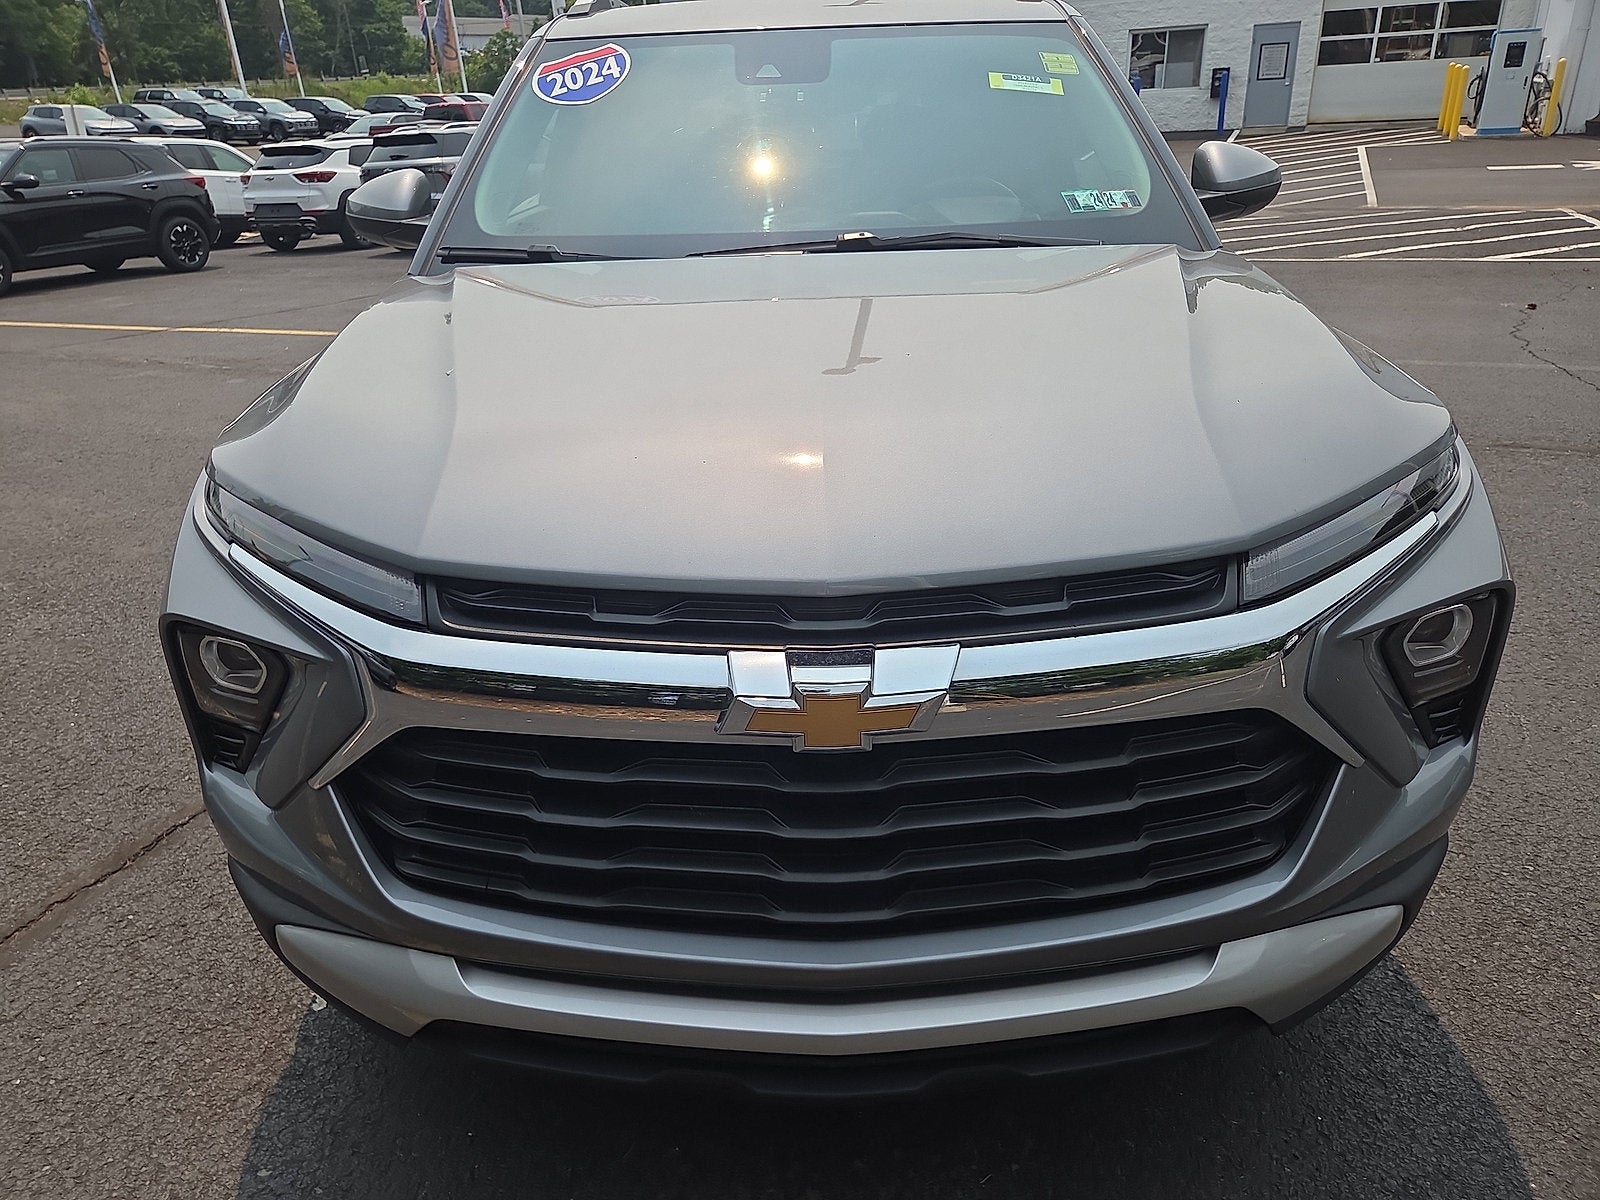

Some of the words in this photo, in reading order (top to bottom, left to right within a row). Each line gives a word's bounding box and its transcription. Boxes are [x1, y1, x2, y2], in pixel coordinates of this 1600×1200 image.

[546, 56, 621, 97] 2024
[1089, 192, 1104, 207] 24
[1103, 192, 1117, 206] 24
